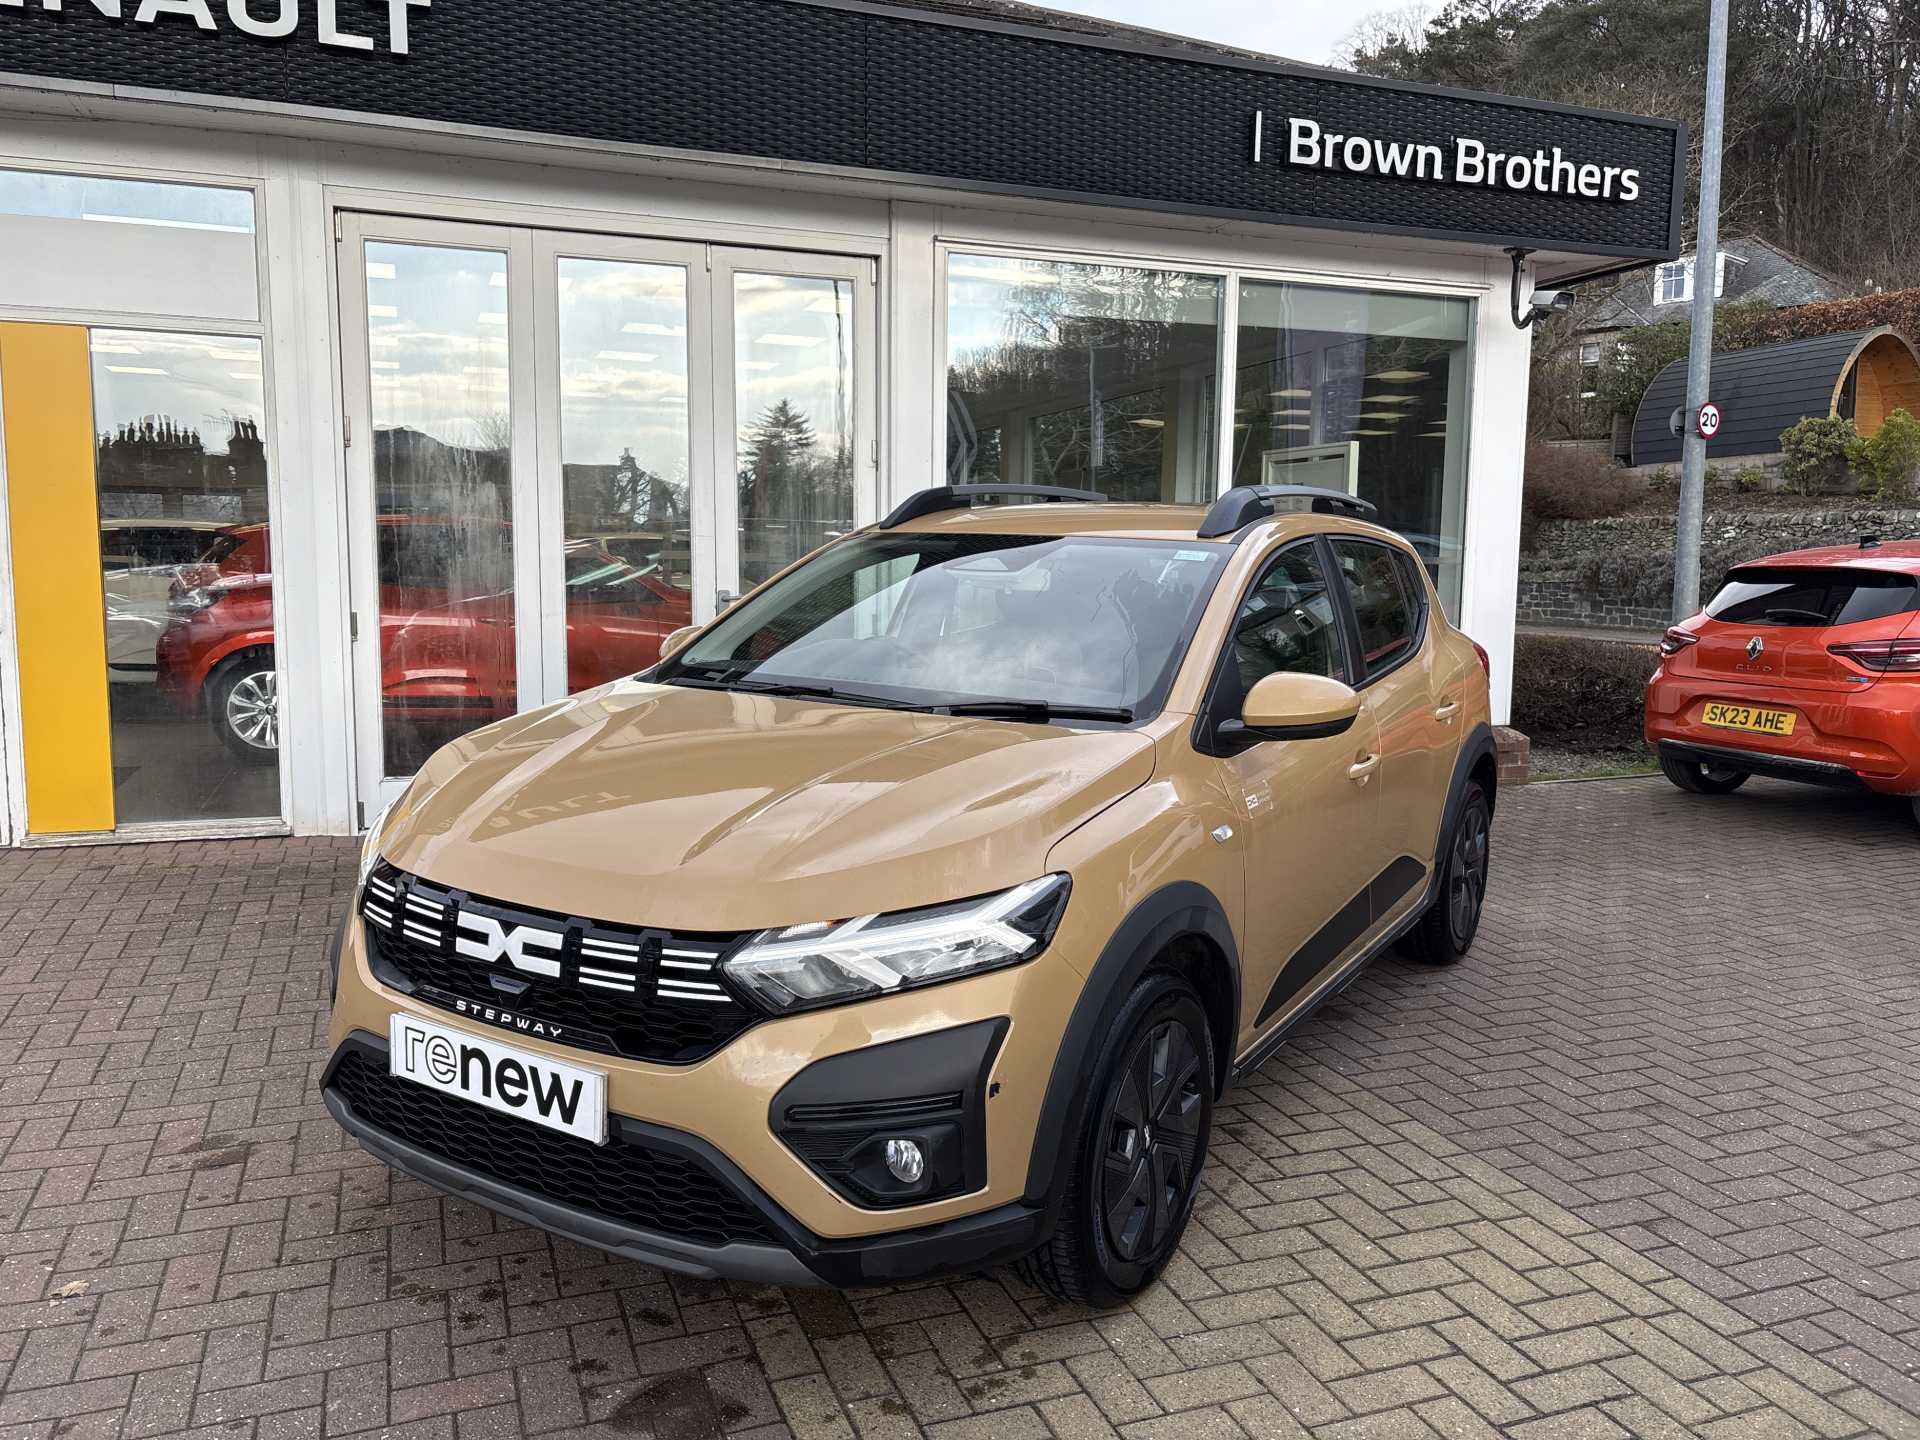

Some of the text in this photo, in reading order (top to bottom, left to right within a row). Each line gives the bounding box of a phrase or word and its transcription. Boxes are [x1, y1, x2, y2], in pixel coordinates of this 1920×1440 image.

[1289, 117, 1640, 201] Brown Brothers
[1701, 412, 1718, 428] 20
[1708, 705, 1788, 731] SK23 AHE
[455, 999, 564, 1038] STEPWAY
[404, 1026, 585, 1126] renew
